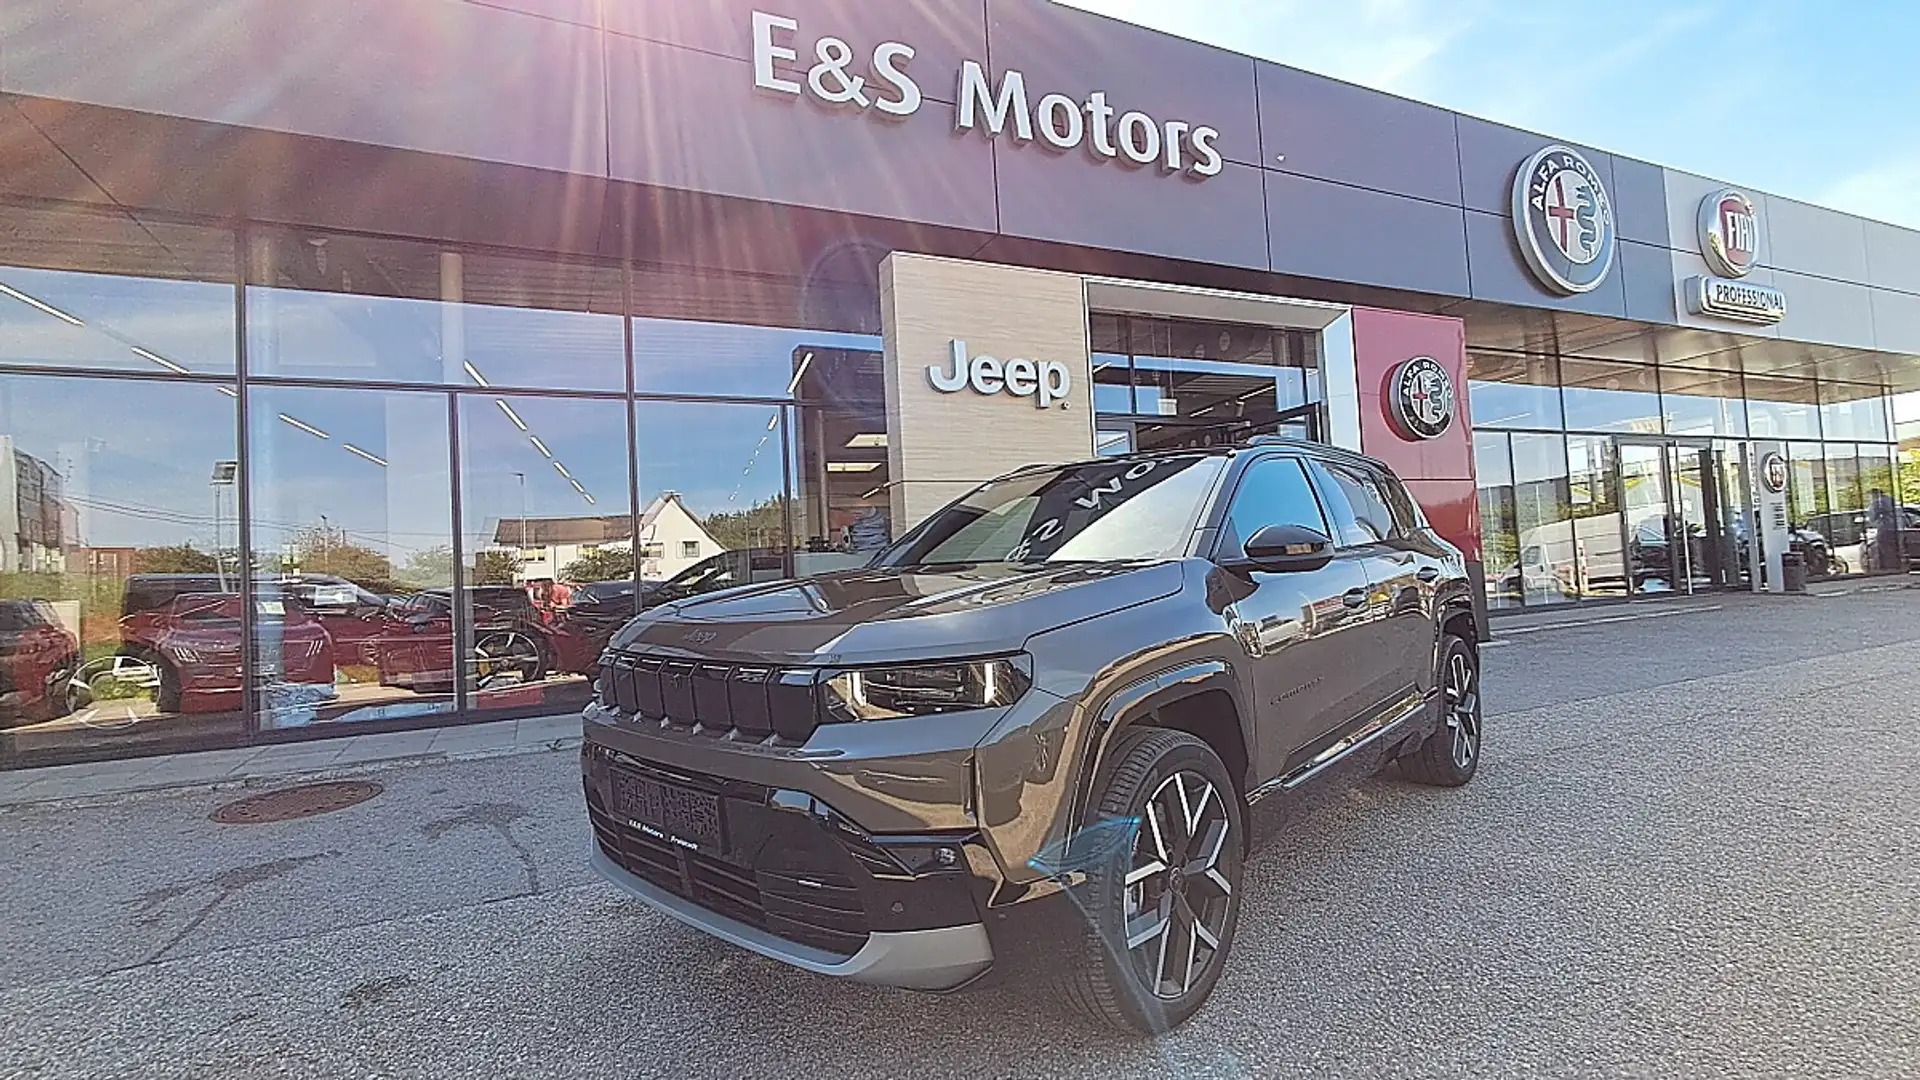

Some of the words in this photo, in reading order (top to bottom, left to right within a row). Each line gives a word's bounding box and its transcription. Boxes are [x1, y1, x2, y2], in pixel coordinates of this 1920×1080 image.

[751, 10, 922, 117] E&S
[955, 60, 1223, 178] Motors
[1531, 160, 1560, 211] ALFA
[1715, 284, 1784, 310] PROFESSIONAL
[925, 338, 1071, 409] Jeep
